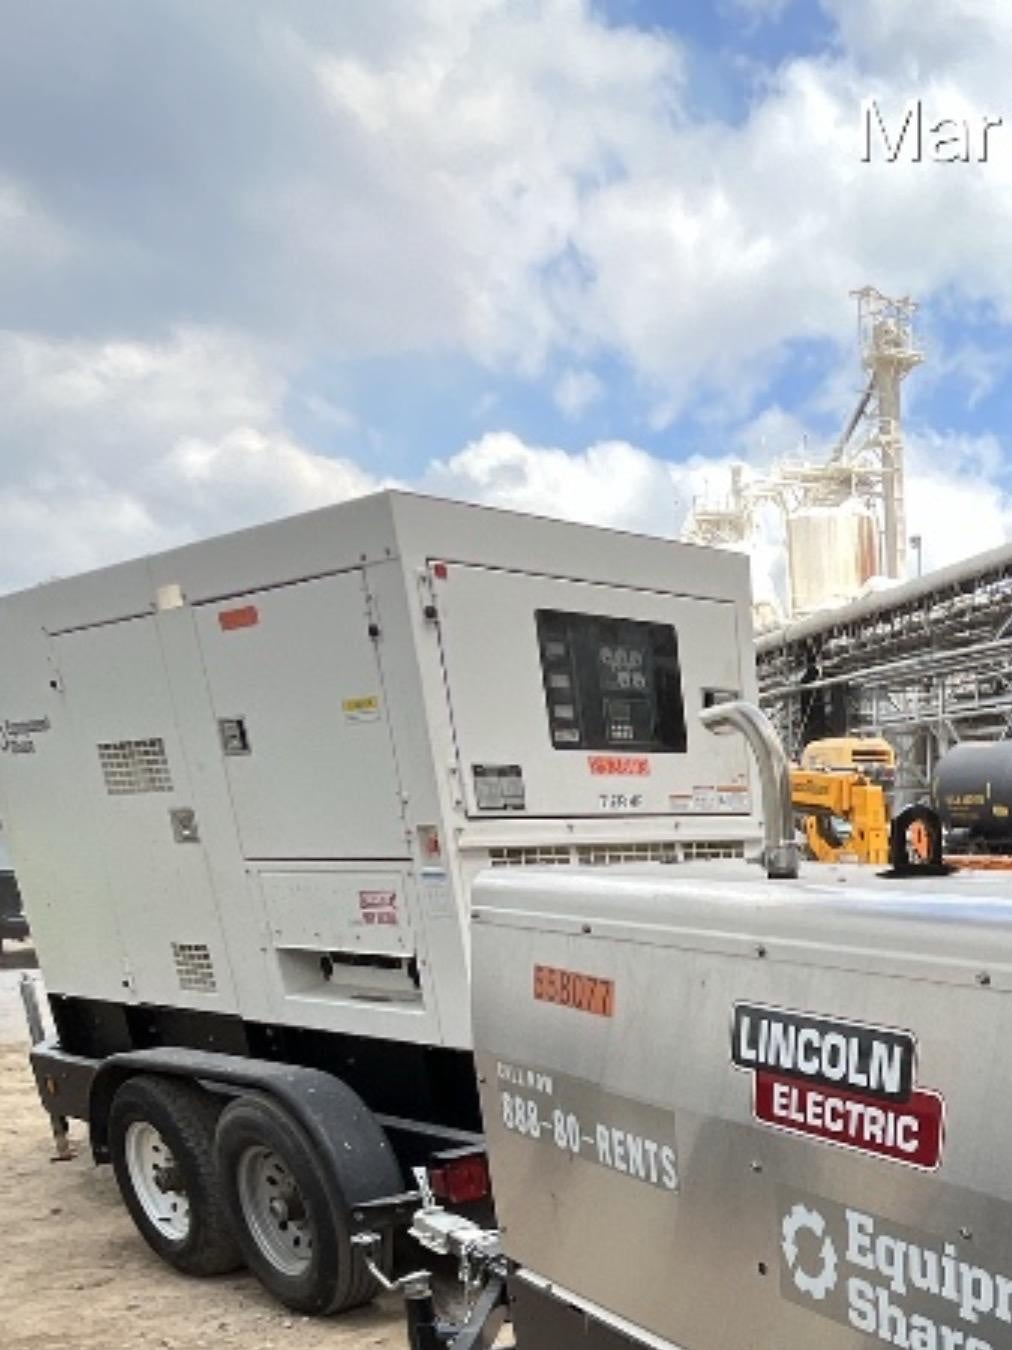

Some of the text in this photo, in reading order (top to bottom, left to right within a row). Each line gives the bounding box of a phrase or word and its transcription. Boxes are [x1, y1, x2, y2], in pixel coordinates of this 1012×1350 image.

[740, 1016, 902, 1094] LINCOLN
[502, 1092, 677, 1190] 888-80-RENTS
[772, 1082, 919, 1153] ELECTRIC
